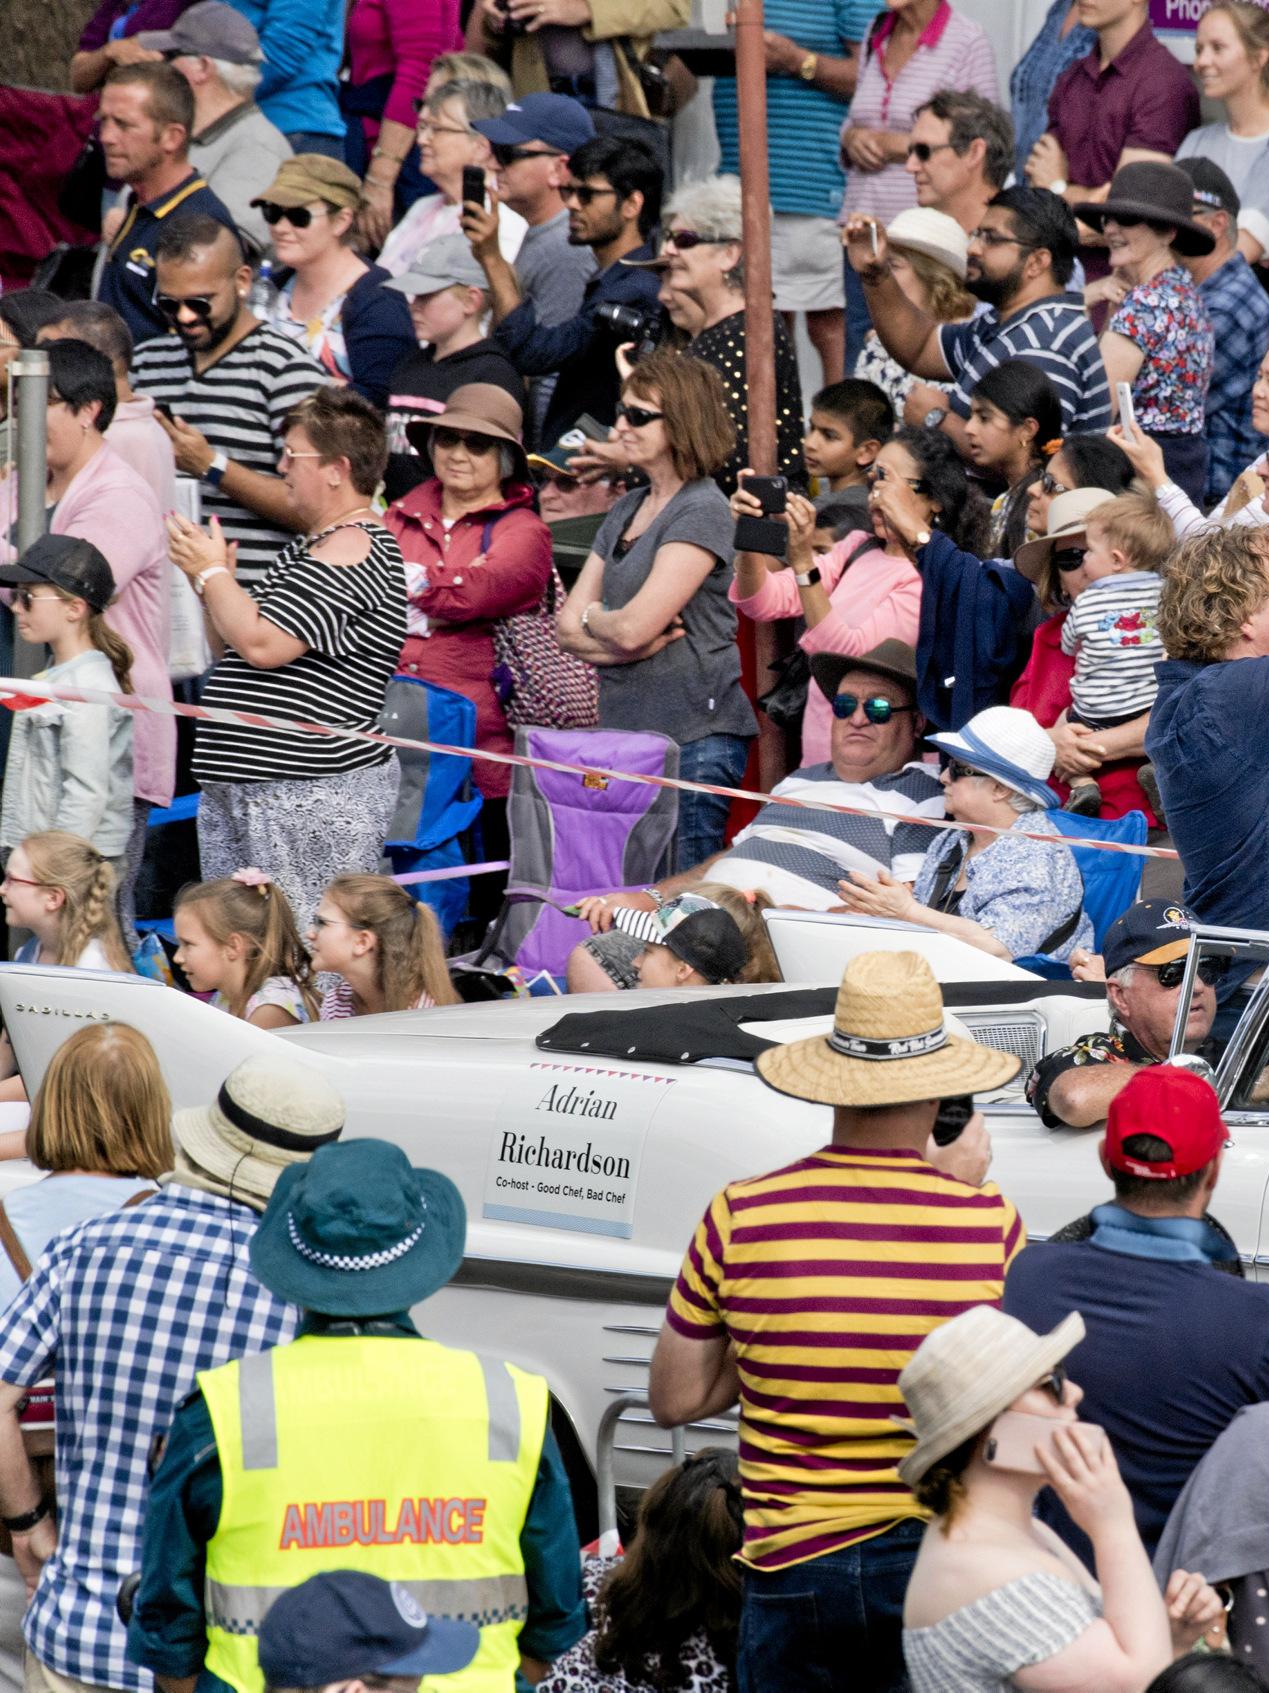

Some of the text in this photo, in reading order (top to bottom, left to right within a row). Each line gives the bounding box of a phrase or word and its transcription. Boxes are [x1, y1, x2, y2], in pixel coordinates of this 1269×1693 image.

[16, 1003, 111, 1021] CADILLAC
[535, 1084, 618, 1120] Adrian
[498, 1131, 630, 1179] Richardson
[496, 1176, 529, 1191] Co-host
[537, 1182, 561, 1195] Good
[563, 1184, 584, 1199] Chef,
[586, 1188, 603, 1201] Bad
[605, 1191, 626, 1205] Chef
[280, 1498, 487, 1550] AMBULANCE
